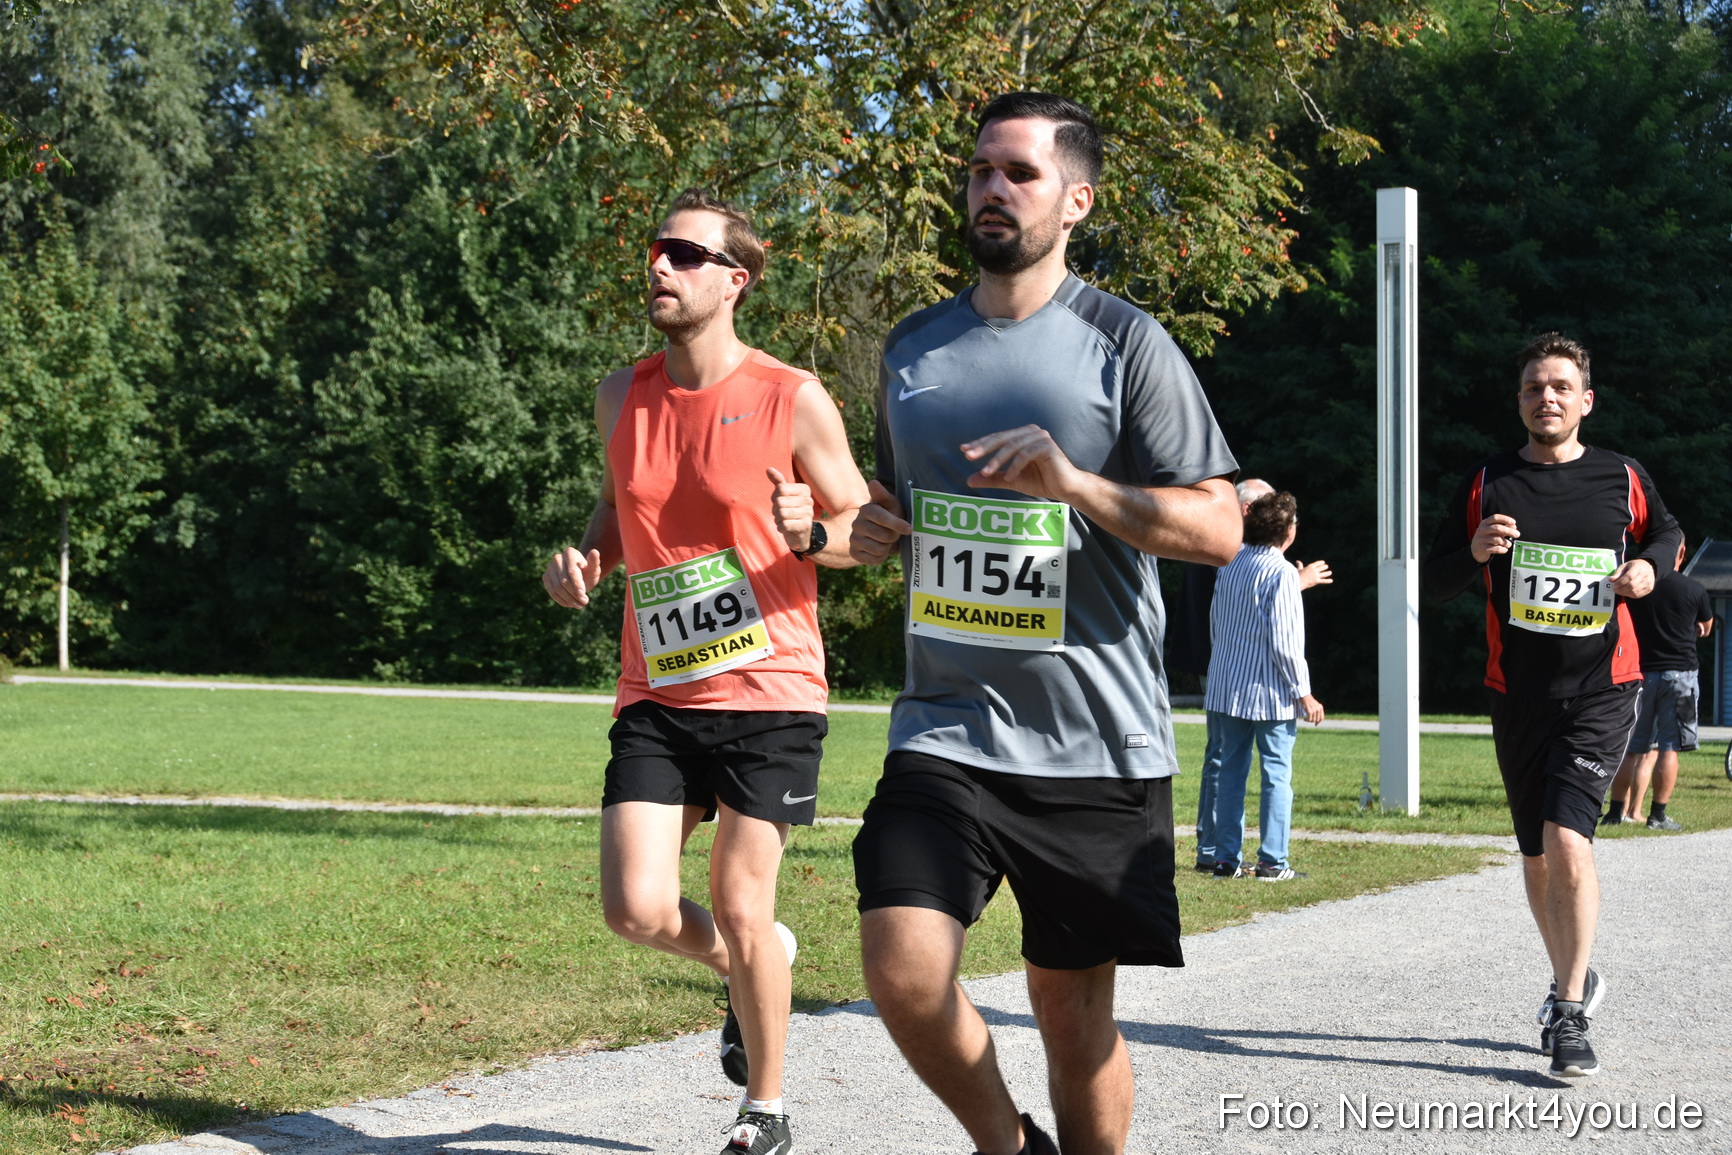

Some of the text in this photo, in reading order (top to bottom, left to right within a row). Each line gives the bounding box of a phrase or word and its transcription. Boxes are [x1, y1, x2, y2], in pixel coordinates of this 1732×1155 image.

[922, 498, 1053, 541] BOCK
[929, 545, 1045, 598] 1154
[1520, 546, 1609, 572] BOCK
[635, 554, 736, 603] BOCK
[1523, 575, 1600, 606] 1221
[648, 592, 743, 646] 1149
[923, 600, 1046, 630] ALEXANDER
[1525, 609, 1593, 626] BASTIAN
[657, 633, 754, 671] SEBASTIAN
